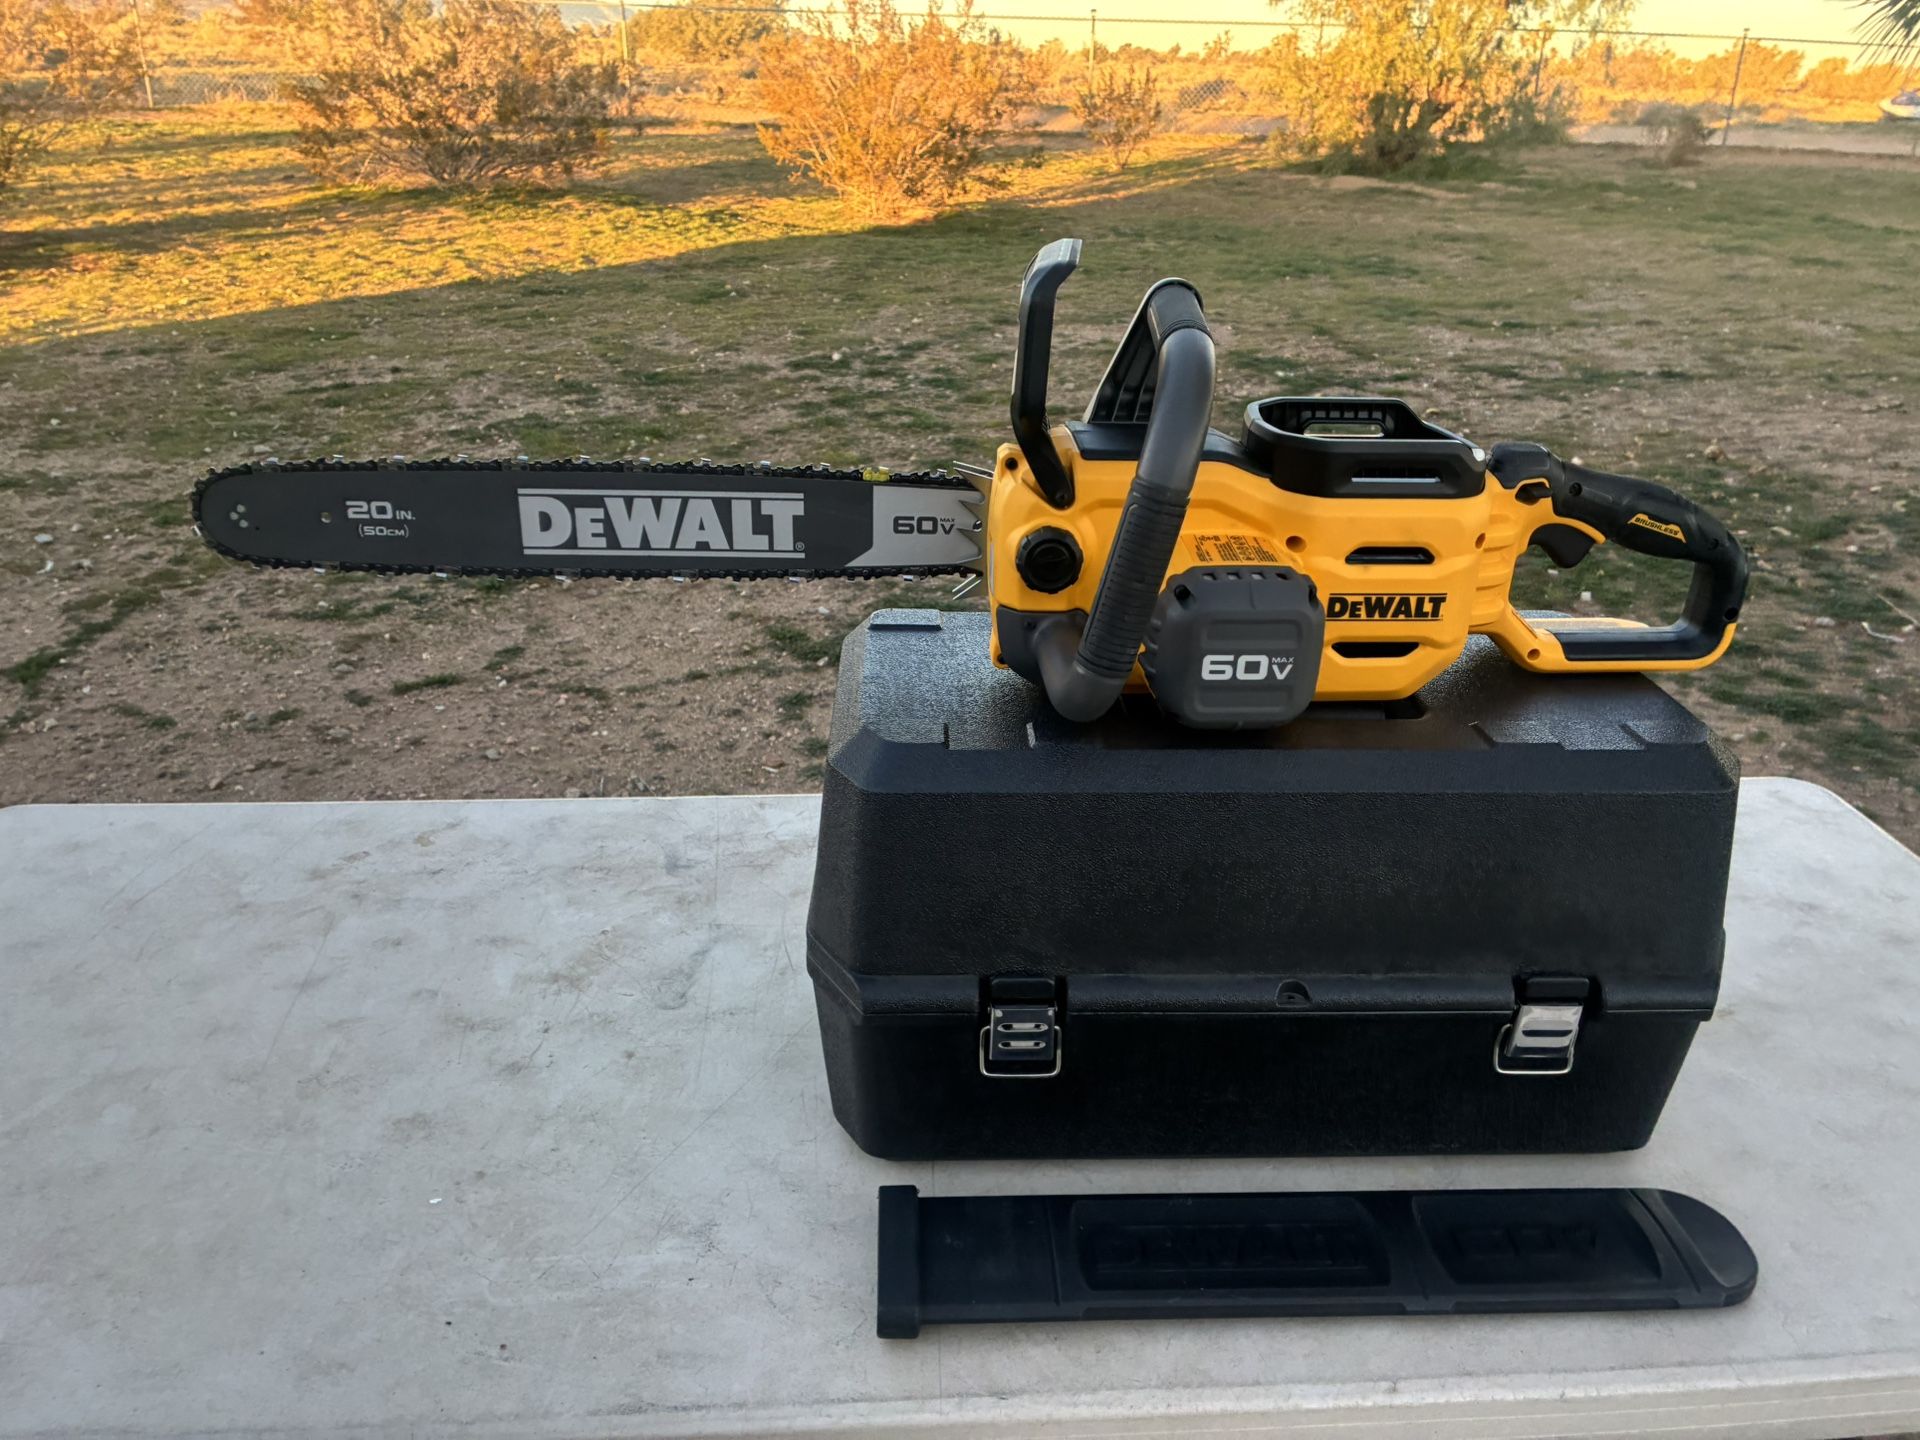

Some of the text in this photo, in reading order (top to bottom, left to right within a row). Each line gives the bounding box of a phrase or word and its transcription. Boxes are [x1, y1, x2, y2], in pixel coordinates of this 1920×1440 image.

[346, 500, 394, 520] 20
[1635, 517, 1680, 536] BRUSHLESS
[1271, 656, 1295, 664] MAX
